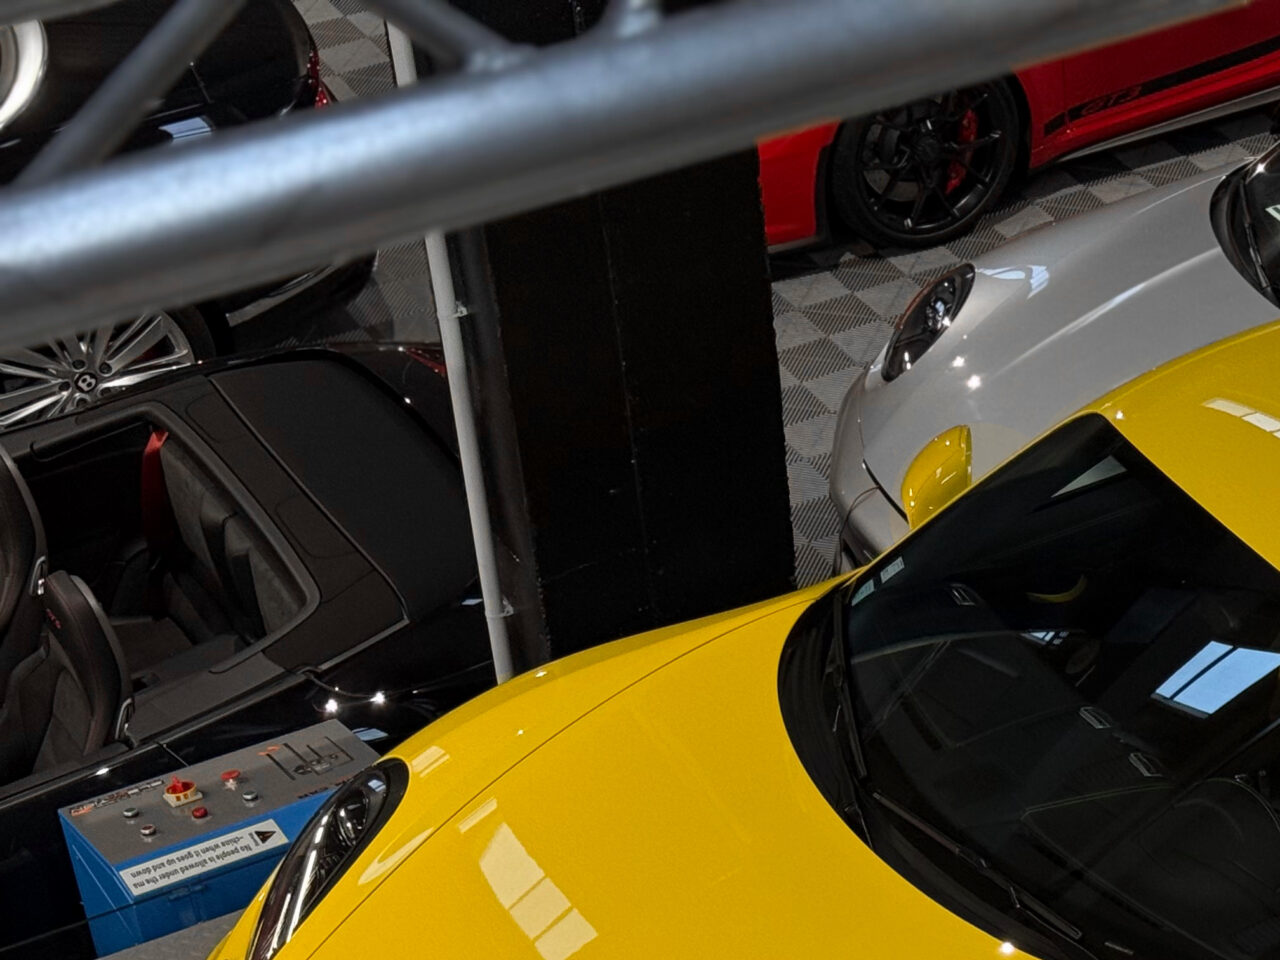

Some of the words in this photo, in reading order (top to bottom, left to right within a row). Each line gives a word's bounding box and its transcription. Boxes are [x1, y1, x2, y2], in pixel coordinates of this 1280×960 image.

[201, 843, 221, 855] when
[239, 843, 253, 852] No
[176, 851, 194, 862] goes
[193, 849, 202, 857] it
[216, 847, 240, 861] people
[166, 858, 177, 866] up
[208, 855, 216, 863] is
[151, 862, 166, 872] and
[180, 858, 208, 874] allowed
[130, 866, 152, 878] down
[159, 868, 180, 880] under
[132, 880, 145, 889] ma
[145, 875, 159, 884] the
